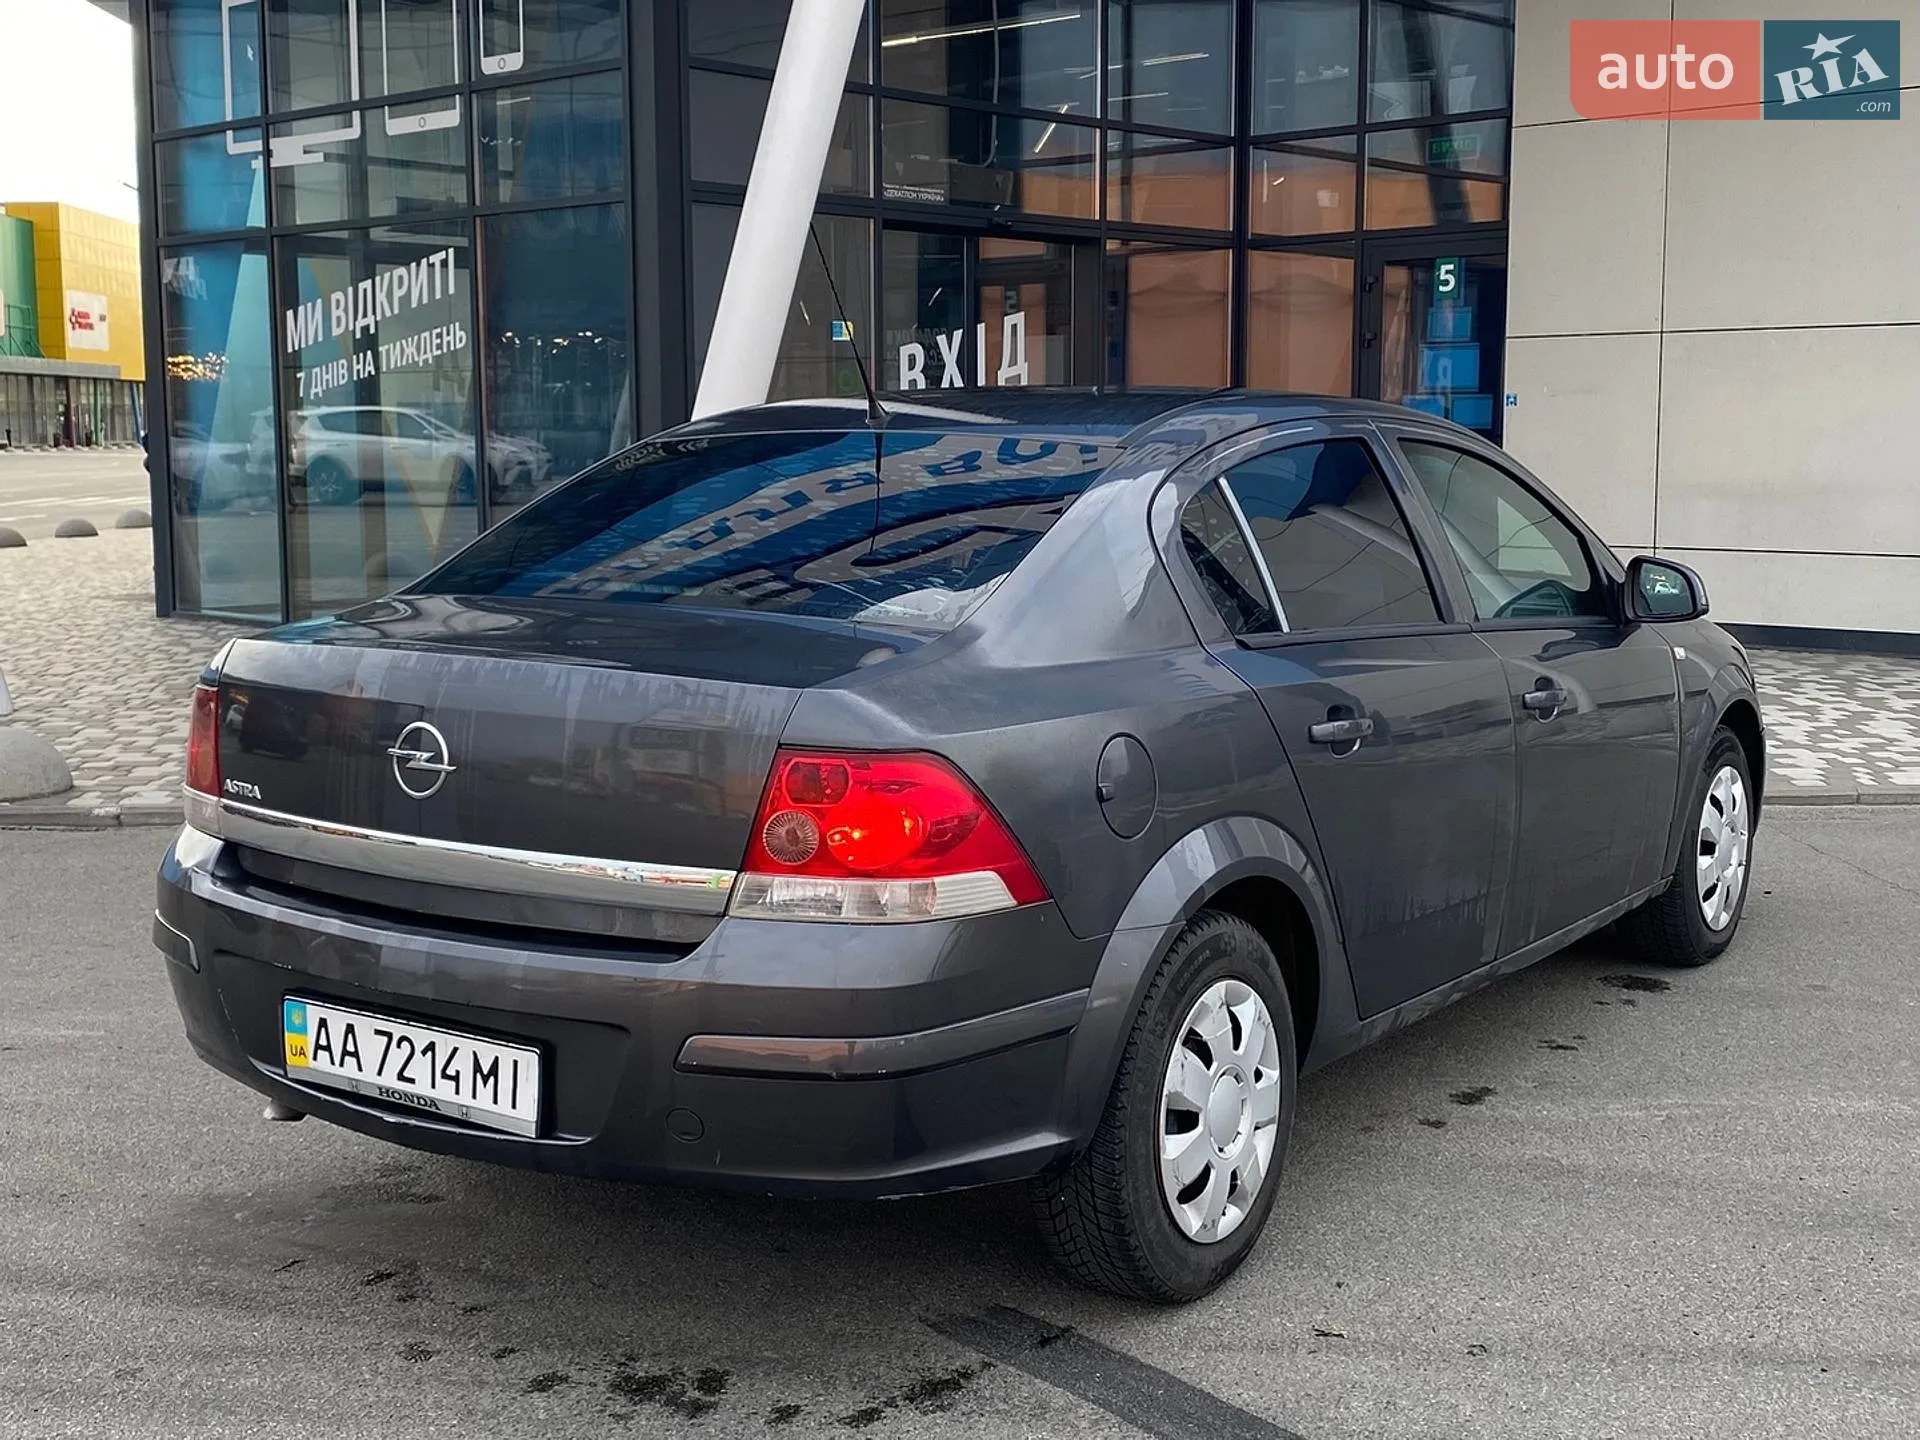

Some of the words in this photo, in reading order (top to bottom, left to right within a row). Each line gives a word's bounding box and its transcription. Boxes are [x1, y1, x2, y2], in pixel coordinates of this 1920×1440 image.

[1438, 263, 1456, 292] 5
[286, 298, 324, 353] МИ
[330, 247, 455, 339] ВІДКРИТІ
[296, 371, 305, 397] 7
[310, 358, 348, 399] ДНІВ
[352, 350, 375, 381] НА
[379, 321, 467, 367] ТИЖДЕНЬ
[223, 778, 262, 800] ASTRA
[289, 1044, 307, 1059] UA
[378, 1086, 441, 1112] HONDA
